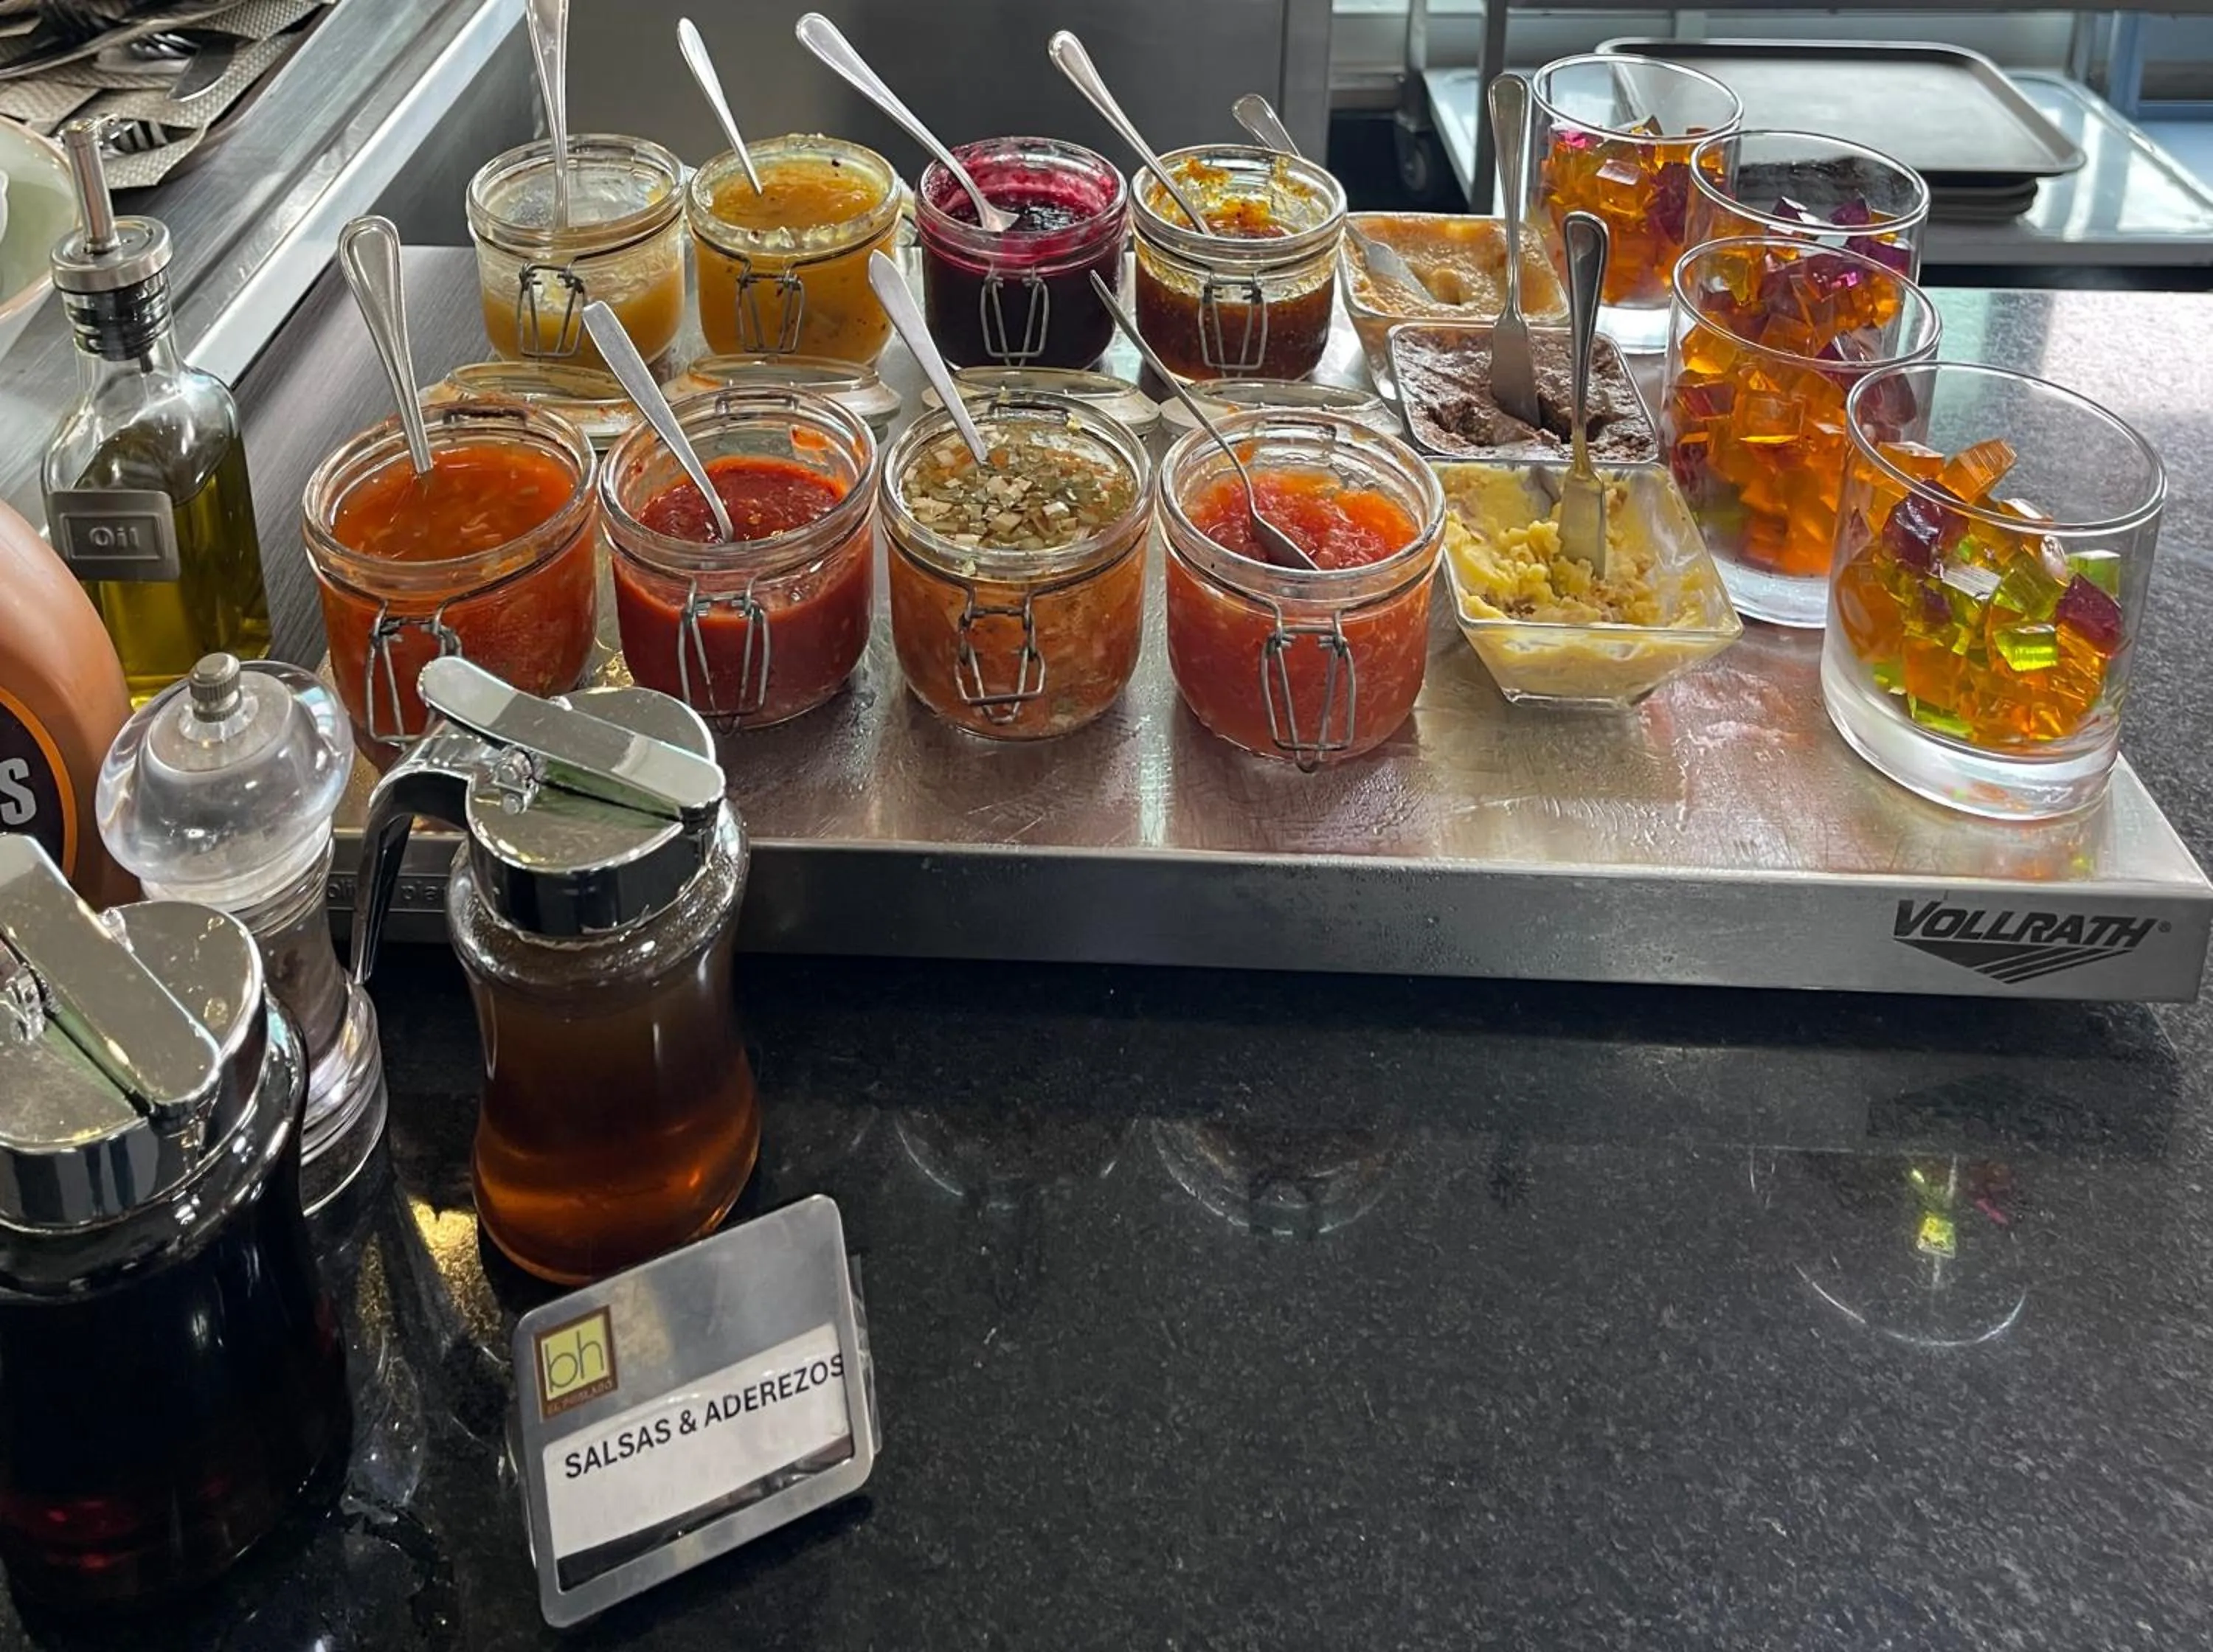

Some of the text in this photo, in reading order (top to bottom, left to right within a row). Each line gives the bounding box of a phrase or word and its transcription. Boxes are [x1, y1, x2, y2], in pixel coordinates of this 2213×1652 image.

[89, 526, 140, 547] Oil
[1894, 899, 2158, 948] VOLLRATH
[544, 1330, 605, 1393] bh
[564, 1352, 845, 1479] SALSAS & ADEREZOS
